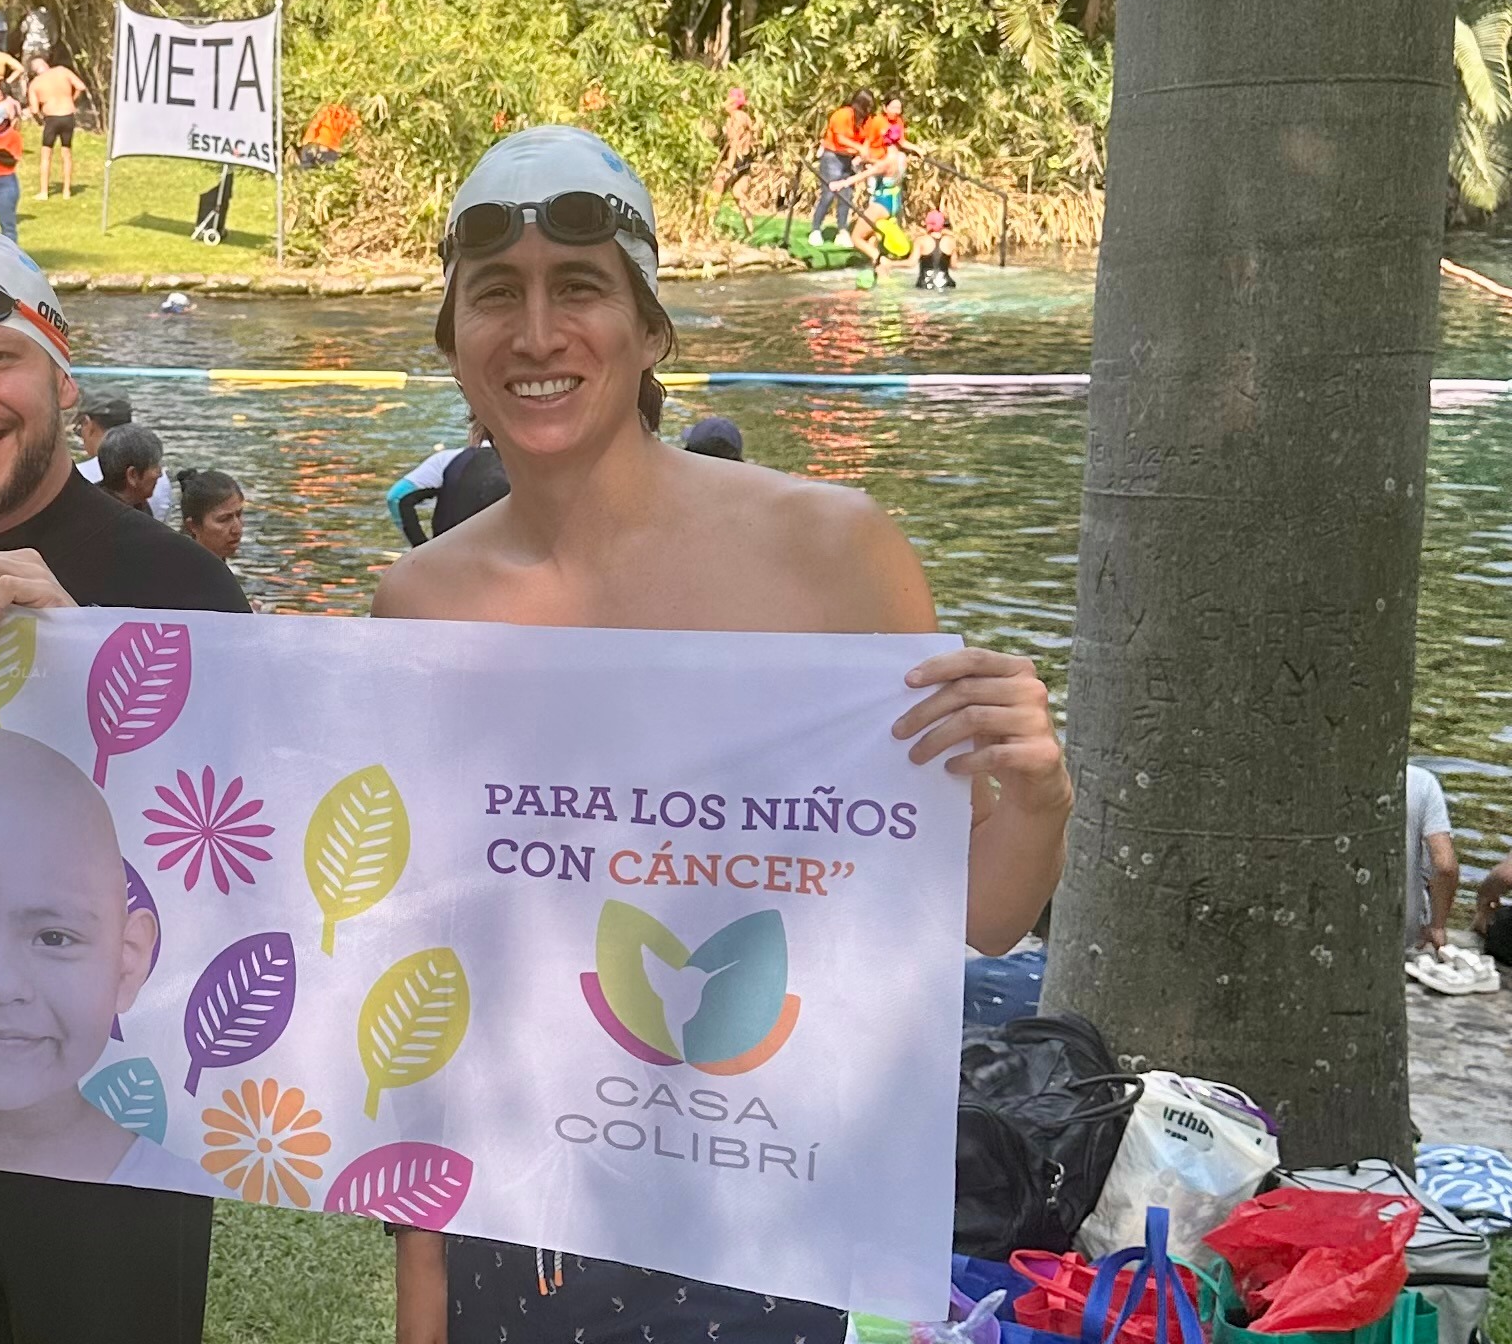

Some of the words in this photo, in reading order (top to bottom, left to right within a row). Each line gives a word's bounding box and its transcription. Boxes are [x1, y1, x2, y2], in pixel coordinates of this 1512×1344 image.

[124, 23, 266, 113] META
[191, 132, 271, 164] ESTACAS
[37, 300, 69, 338] aren
[484, 784, 618, 822] PARA
[630, 788, 726, 831] LOS
[742, 785, 918, 840] NIÑOS
[486, 838, 595, 882] CON
[595, 1076, 778, 1130] CASA
[555, 1114, 821, 1182] COLIBRÍ
